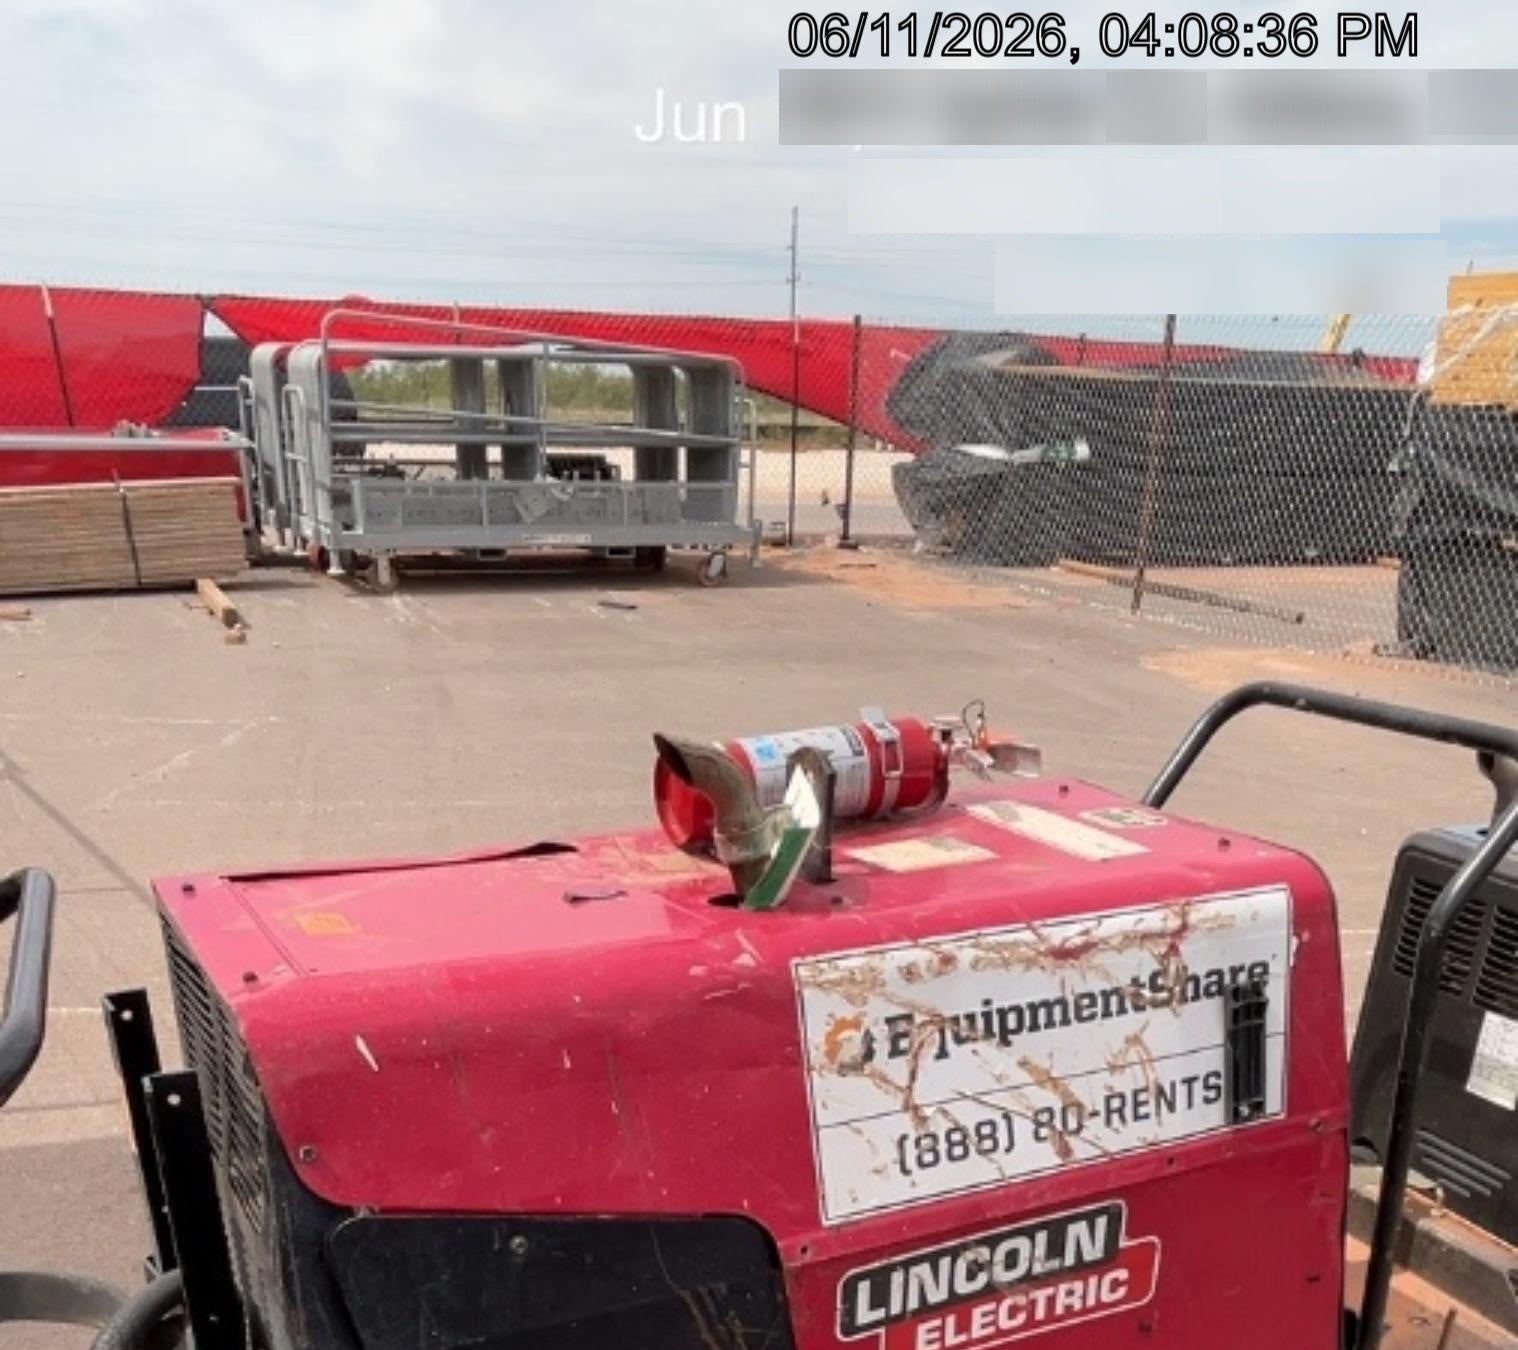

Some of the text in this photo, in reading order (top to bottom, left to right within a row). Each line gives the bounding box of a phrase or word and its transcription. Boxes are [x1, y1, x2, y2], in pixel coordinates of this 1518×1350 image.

[897, 1070, 1223, 1176] (888) 80-RENTS
[854, 1214, 1109, 1327] LINCOLN
